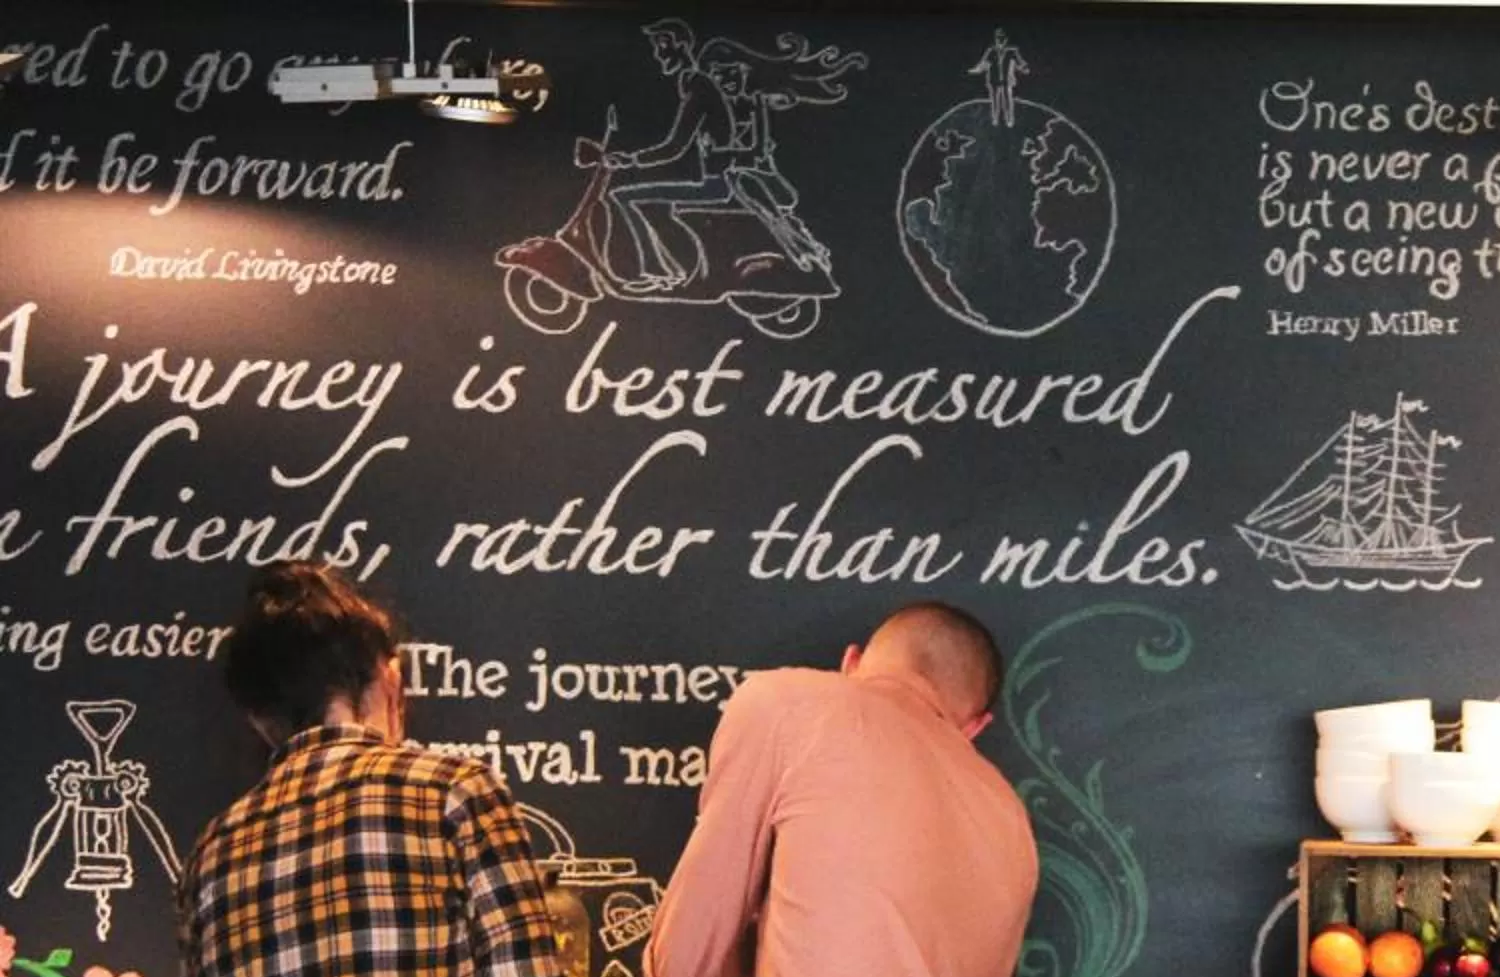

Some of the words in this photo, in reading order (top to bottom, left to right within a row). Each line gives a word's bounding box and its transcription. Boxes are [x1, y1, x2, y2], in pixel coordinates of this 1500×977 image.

[112, 40, 169, 89] to
[175, 50, 253, 112] go
[1259, 77, 1391, 132] One's
[35, 134, 80, 192] it
[97, 131, 158, 193] be
[149, 134, 414, 215] forward.
[1257, 141, 1293, 183] is
[1308, 149, 1431, 183] never
[1443, 151, 1469, 183] a
[1258, 180, 1334, 229] but
[1343, 198, 1372, 233] a
[1386, 202, 1479, 232] new
[110, 246, 216, 280] David
[211, 248, 398, 295] Livingstone
[1264, 228, 1321, 293] of
[1323, 236, 1463, 300] seeing
[1266, 310, 1361, 342] Henry
[1366, 310, 1460, 337] Miller
[31, 324, 403, 488] journey
[451, 335, 526, 413] is
[565, 321, 744, 418] best
[765, 285, 1242, 436] measured
[64, 414, 410, 583] friends,
[435, 428, 716, 579] rather
[749, 433, 964, 584] than
[980, 450, 1220, 589] miles.
[85, 610, 235, 661] easier
[400, 643, 509, 698] The
